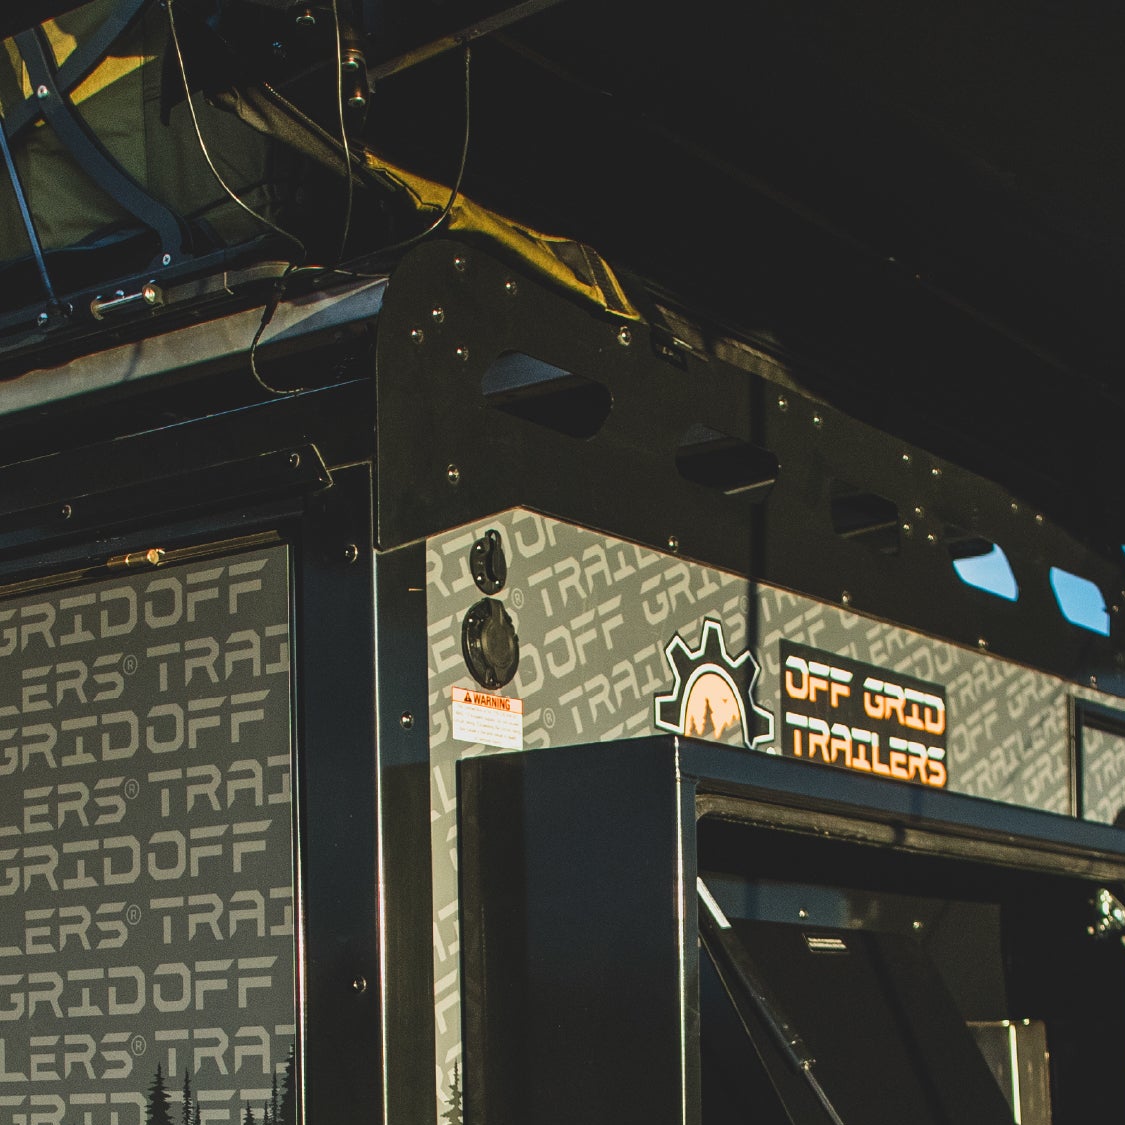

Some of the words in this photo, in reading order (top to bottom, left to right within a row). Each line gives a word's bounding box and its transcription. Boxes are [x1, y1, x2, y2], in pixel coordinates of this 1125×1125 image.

[473, 692, 511, 711] WARNING
[785, 655, 853, 708] OFF
[863, 677, 946, 735] GRID
[785, 712, 946, 788] TRAILERS
